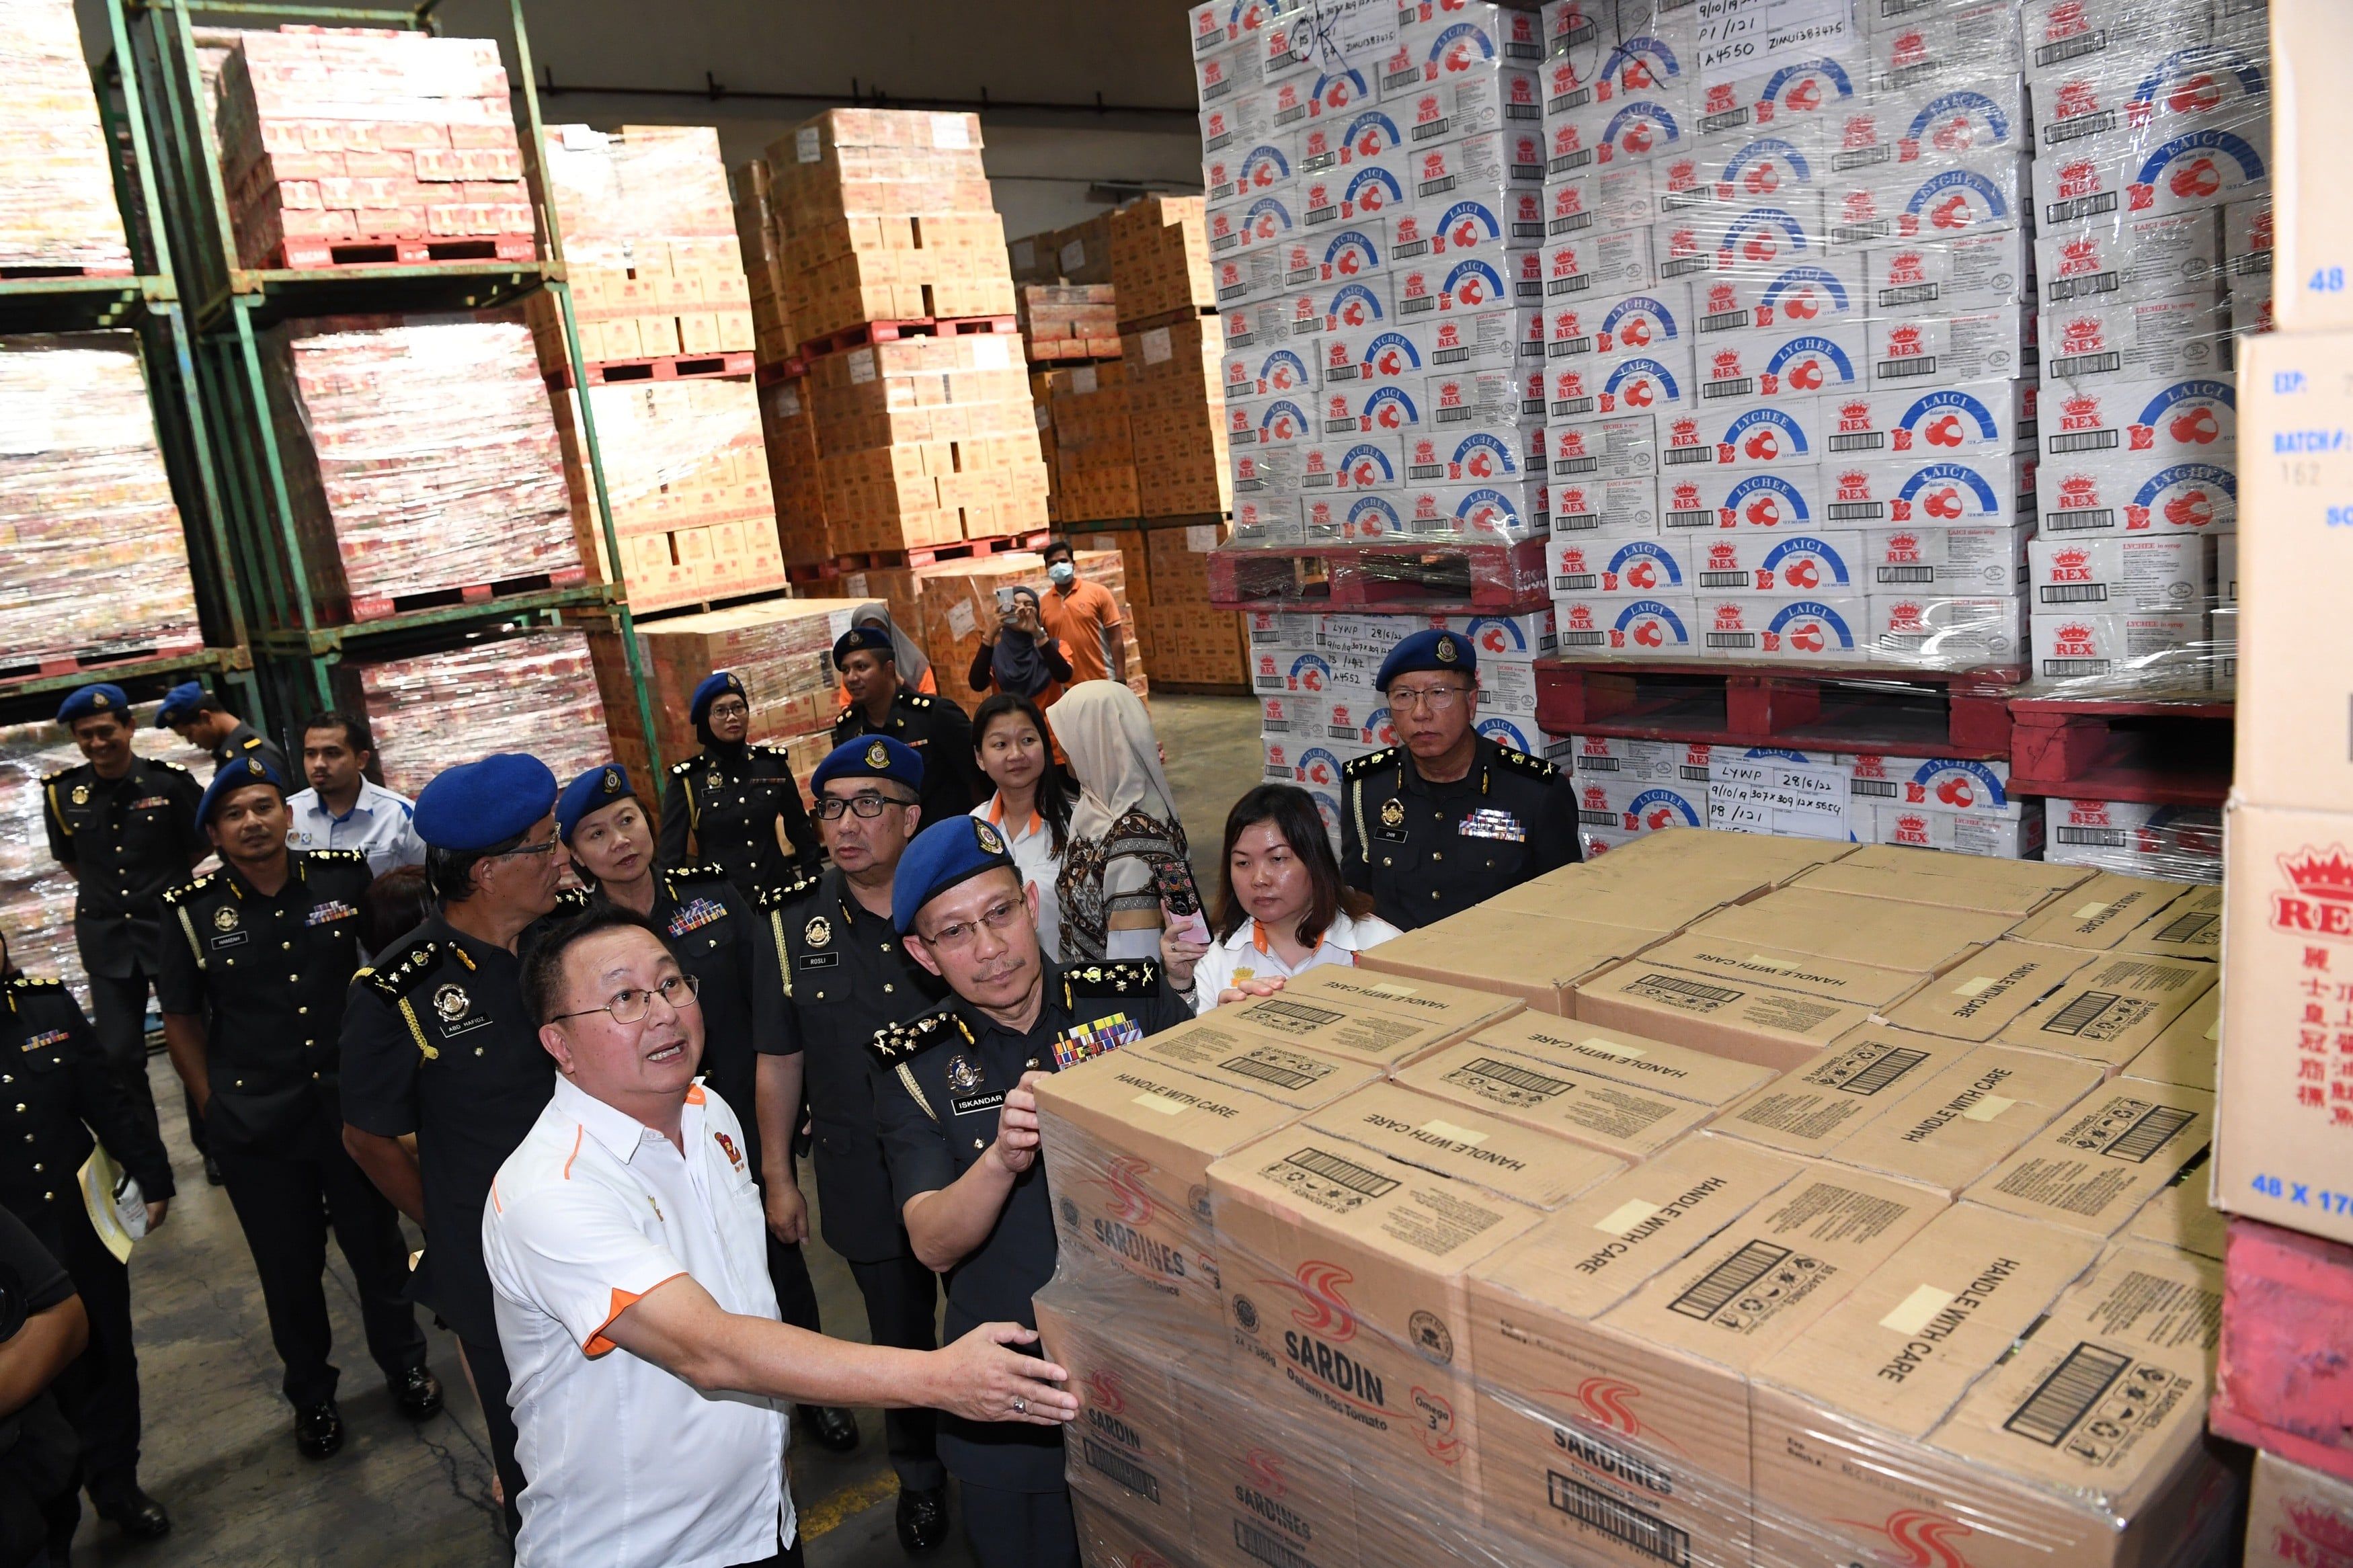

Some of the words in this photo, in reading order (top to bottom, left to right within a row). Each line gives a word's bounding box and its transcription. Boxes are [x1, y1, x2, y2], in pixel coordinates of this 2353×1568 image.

[1556, 140, 1580, 154] REX
[1424, 166, 1445, 179] REX
[1450, 203, 1479, 218] LAICI
[1556, 201, 1581, 215] REX
[1398, 230, 1419, 243] REX
[1456, 262, 1484, 276] LAICI
[1553, 263, 1579, 276] REX
[2060, 259, 2100, 276] REX
[1890, 270, 1924, 284] REX
[2307, 266, 2344, 292] 48
[1405, 286, 1425, 298] REX
[1613, 300, 1659, 319] LYCHEE
[1708, 300, 1737, 313] REX
[1556, 327, 1581, 338] REX
[1370, 333, 1407, 352] LYCHEE
[1438, 336, 1460, 347] REX
[1778, 338, 1834, 362] LYCHEE
[1889, 343, 1923, 357] REX
[1330, 356, 1349, 366] REX
[1619, 361, 1655, 375] LAICI
[1712, 366, 1741, 378] REX
[1375, 388, 1401, 401] LAICI
[1558, 386, 1583, 398] REX
[2166, 384, 2225, 402] LAICI
[1441, 396, 1461, 407] REX
[1923, 393, 1968, 409] LAICI
[1330, 407, 1348, 417] REX
[1736, 411, 1789, 431] LYCHEE
[1839, 419, 1871, 430] REX
[2063, 417, 2102, 429] REX
[1460, 436, 1500, 452] LYCHEE
[1672, 434, 1700, 446] REX
[1415, 454, 1436, 464] REX
[1560, 446, 1585, 457] REX
[1923, 466, 1966, 481] LAICI
[1737, 478, 1789, 496] LYCHEE
[1839, 489, 1869, 499] REX
[1470, 490, 1499, 503] LAICI
[1673, 498, 1701, 509] REX
[2059, 495, 2099, 507] REX
[1562, 502, 1586, 513] REX
[1624, 544, 1658, 556] LAICI
[1782, 540, 1822, 553] LAICI
[1710, 559, 1737, 569] REX
[1887, 552, 1919, 562] REX
[1562, 563, 1585, 573] REX
[2053, 569, 2091, 581] REX
[1630, 603, 1665, 614] LAICI
[1788, 604, 1827, 617] LAICI
[1569, 620, 1593, 629] REX
[1716, 620, 1743, 630] REX
[2056, 643, 2094, 655] REX
[1584, 745, 1608, 754] REX
[1722, 767, 1762, 780] LYWP
[1853, 766, 1886, 778] REX
[1783, 774, 1832, 791] 28/6/22
[1584, 798, 1607, 809] REX
[1639, 789, 1685, 808] LYCHEE
[1752, 789, 1768, 799] 307
[1778, 794, 1794, 807] 309
[2069, 812, 2110, 825] REX
[1897, 831, 1928, 843] REX
[2110, 891, 2147, 911] HANDLE
[2096, 905, 2122, 921] WITH
[2075, 917, 2106, 935] CARE
[810, 957, 826, 966] ROSLI
[1693, 953, 1738, 966] CARE
[1737, 958, 1777, 975] WITH
[1777, 968, 1847, 987] HANDLE
[1997, 962, 2041, 989] HANDLE
[1322, 980, 1362, 995] CARE
[1358, 985, 1396, 1001] WITH
[1981, 983, 2010, 1001] WITH
[1392, 992, 1450, 1010] HANDLE
[1952, 998, 1988, 1020] CARE
[448, 1024, 462, 1034] ABD
[463, 1016, 486, 1029] HAFIDZ
[1527, 1033, 1573, 1050] CARE
[1570, 1042, 1616, 1060] WITH
[1616, 1053, 1689, 1079] HANDLE
[959, 1094, 1003, 1110] ISKANDAR
[1114, 1073, 1166, 1096] HANDLE
[1163, 1089, 1198, 1107] WITH
[1195, 1100, 1240, 1119] CARE
[1901, 1110, 1958, 1143] HANDLE
[1946, 1089, 1985, 1113] WITH
[1973, 1067, 2013, 1091] CARE
[1363, 1113, 1411, 1133] CARE
[1408, 1123, 1458, 1151] WITH
[1450, 1141, 1527, 1173] HANDLE
[2251, 1173, 2282, 1199] 48
[2290, 1183, 2309, 1204] X
[1660, 1176, 1728, 1221] HANDLE
[1624, 1214, 1671, 1245] WITH
[1094, 1218, 1185, 1277] SARDINES
[1575, 1242, 1629, 1276] CARE
[1954, 1257, 2021, 1311] HANDLE
[1920, 1306, 1967, 1343] WITH
[1285, 1329, 1385, 1407] SARDIN
[1877, 1336, 1932, 1385] CARE
[1287, 1366, 1322, 1402] Dalam
[1324, 1394, 1344, 1414] Sos
[1345, 1405, 1388, 1432] Tomato
[1415, 1396, 1449, 1422] Omega
[1088, 1408, 1140, 1450] SARDIN
[1427, 1415, 1438, 1431] 3
[1554, 1426, 1673, 1495] SARDINES
[1235, 1484, 1312, 1540] SARDINES
